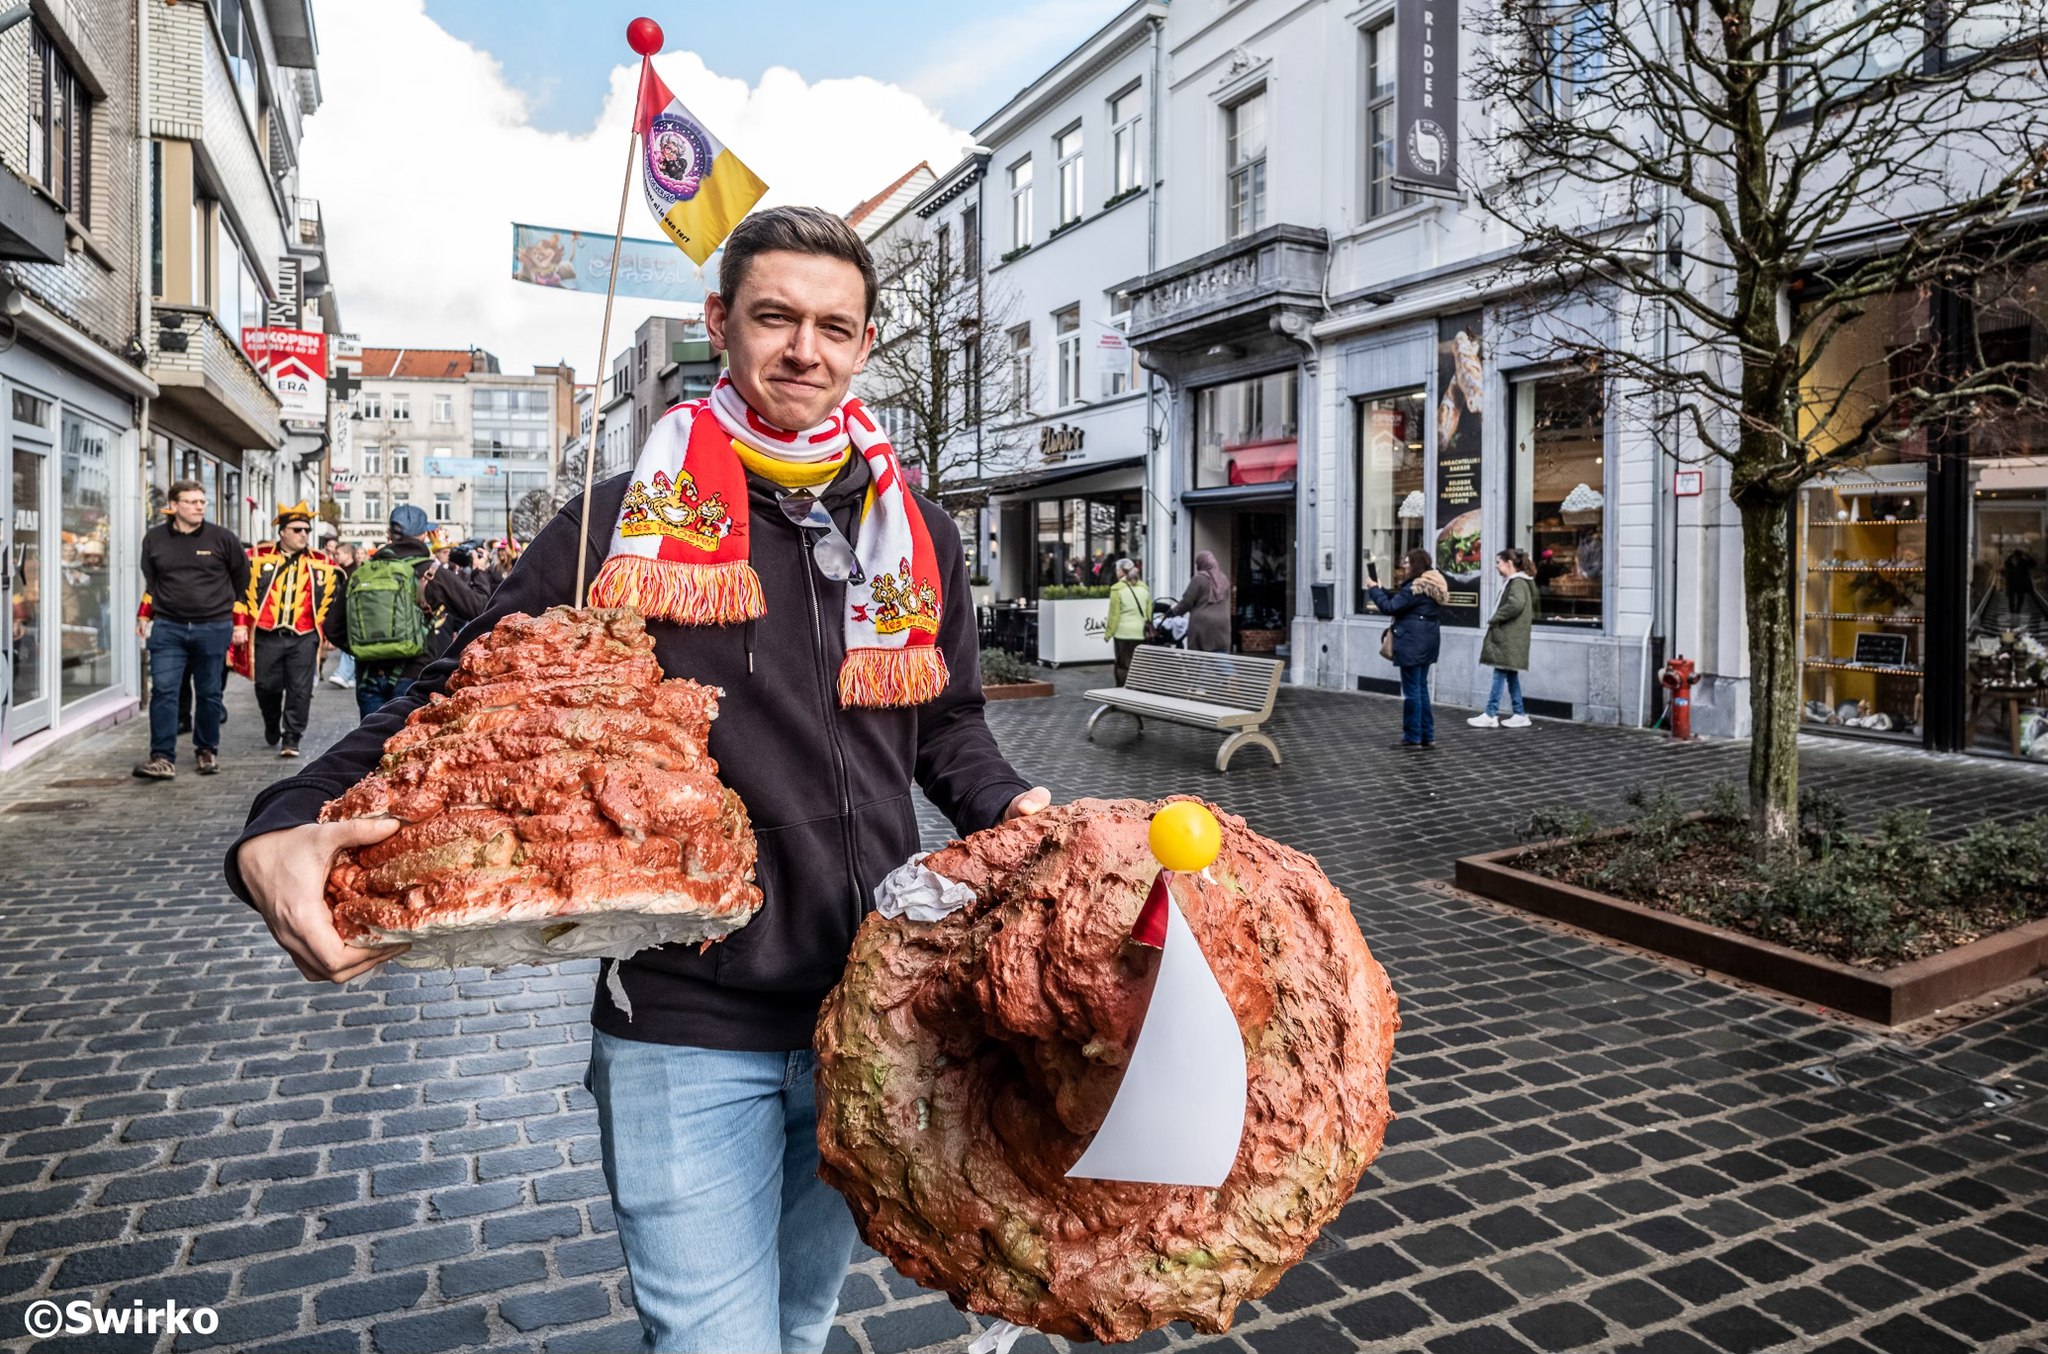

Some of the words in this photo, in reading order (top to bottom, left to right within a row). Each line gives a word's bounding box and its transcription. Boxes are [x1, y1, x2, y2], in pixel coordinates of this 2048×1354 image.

[1424, 11, 1434, 108] RIDDER
[278, 380, 308, 392] ERA
[334, 473, 359, 483] hifi
[677, 530, 715, 547] Oever
